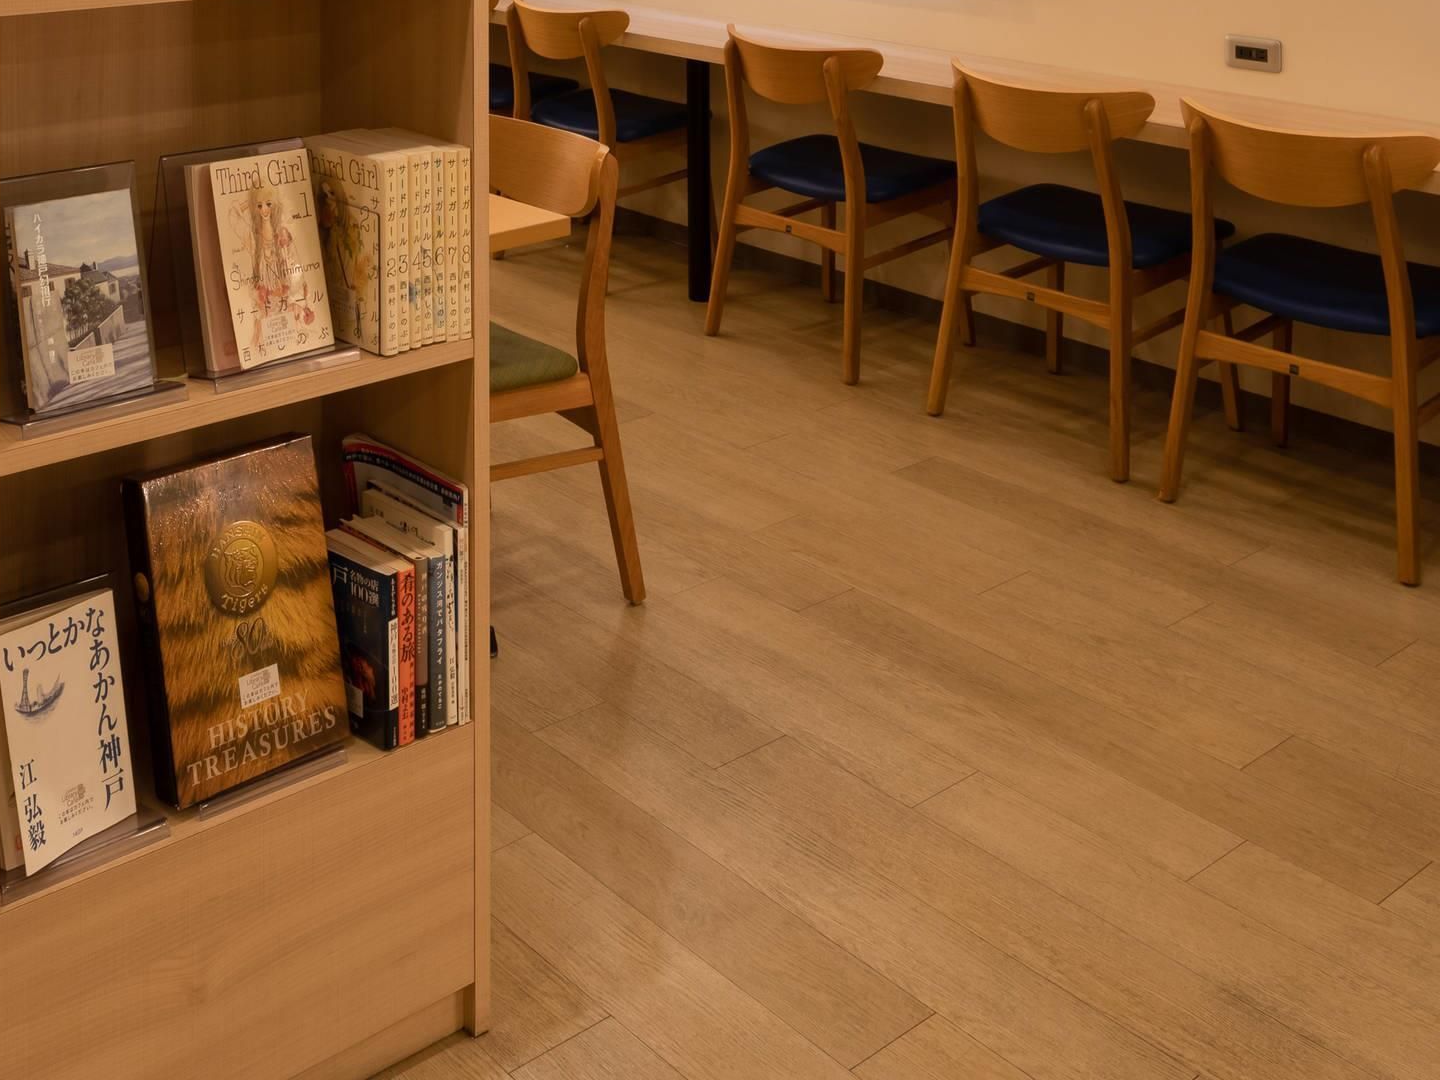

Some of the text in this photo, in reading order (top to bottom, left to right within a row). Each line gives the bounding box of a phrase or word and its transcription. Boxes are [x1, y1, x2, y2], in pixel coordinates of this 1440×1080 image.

[216, 155, 308, 195] Third Girl
[349, 158, 380, 191] Girl
[387, 168, 397, 250] サードガール
[396, 164, 407, 247] サードガール
[422, 160, 431, 241] サードガール
[434, 158, 444, 238] サードガール
[448, 158, 457, 239] サードガール
[461, 158, 470, 237] サードガール
[386, 258, 396, 278] 2
[398, 254, 408, 274] 3
[412, 251, 421, 270] 4
[422, 249, 431, 268] 5
[435, 247, 444, 266] 6
[448, 246, 457, 265] 7
[462, 245, 471, 263] 8
[236, 290, 324, 324] サードガール
[207, 689, 309, 750] HISTORY
[187, 705, 336, 787] TREASURES
[20, 759, 46, 851] 江弘毅
